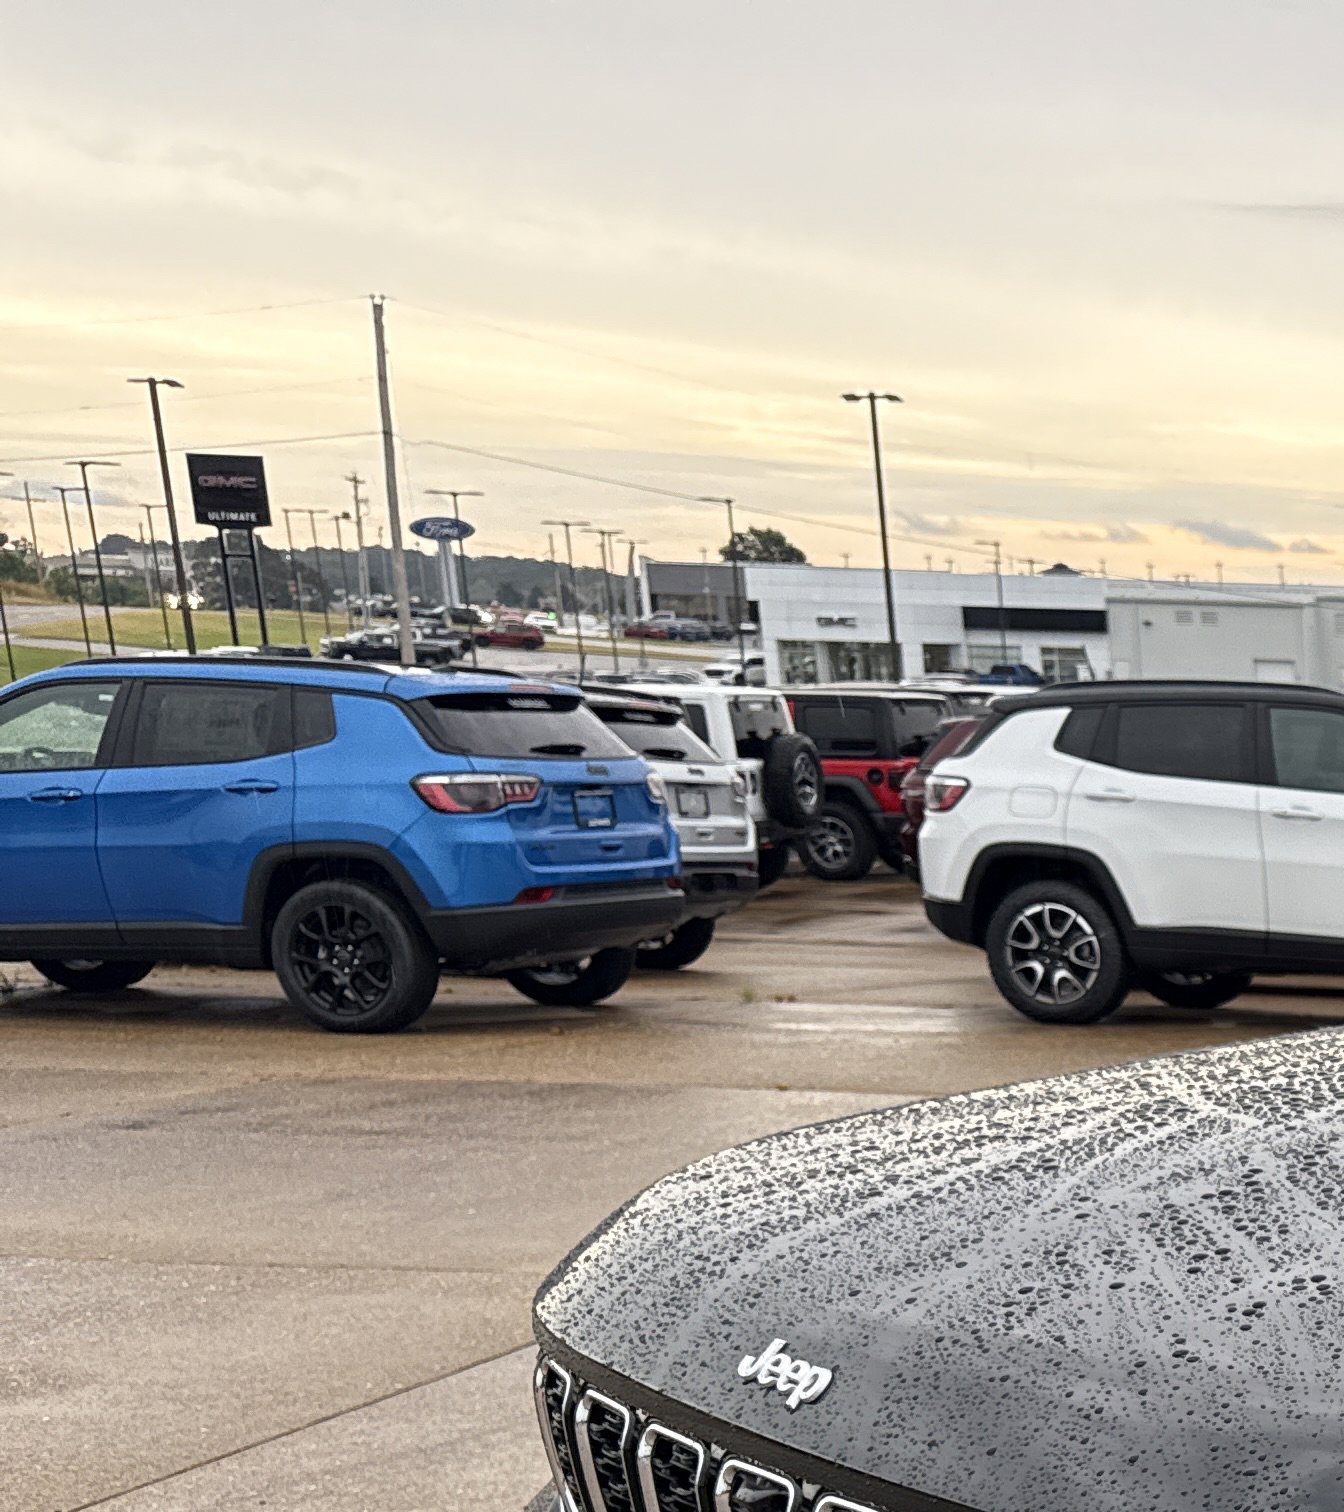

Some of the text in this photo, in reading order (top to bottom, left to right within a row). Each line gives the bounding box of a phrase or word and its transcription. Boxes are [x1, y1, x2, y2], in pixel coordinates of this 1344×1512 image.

[198, 475, 257, 489] GMC
[207, 511, 257, 522] ULTIMATE
[738, 1338, 832, 1409] Jeep
